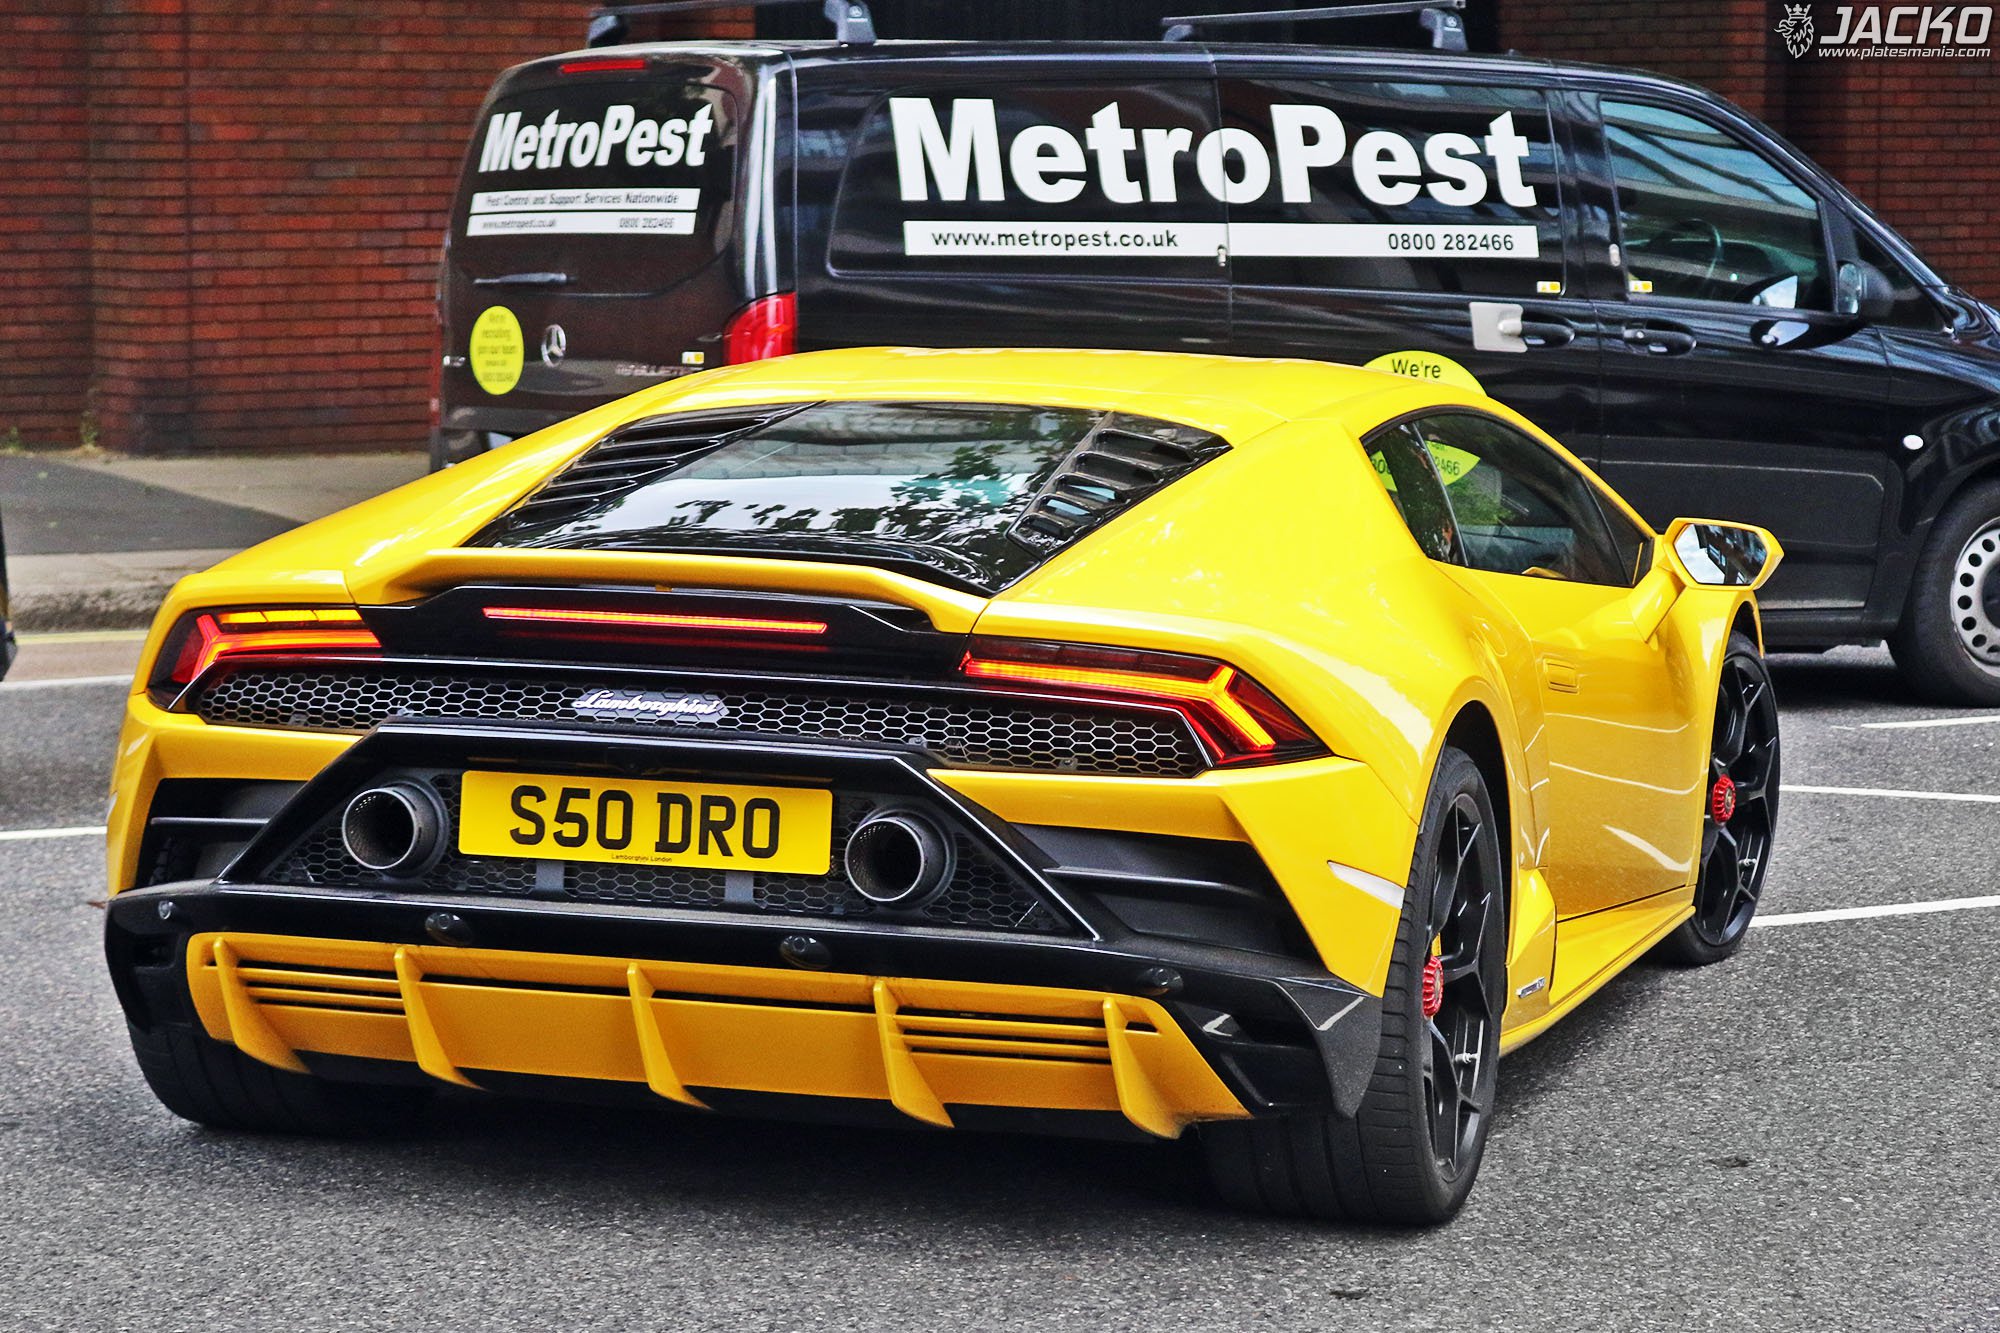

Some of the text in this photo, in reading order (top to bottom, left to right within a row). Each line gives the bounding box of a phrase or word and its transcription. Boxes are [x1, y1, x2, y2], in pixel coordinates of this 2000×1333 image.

[478, 103, 714, 173] MetroPest
[889, 97, 1537, 208] MetroPest
[584, 191, 622, 205] Services
[625, 191, 680, 204] Nationwide
[932, 229, 1514, 251] www.metropest.co.uk 0800 282466
[1391, 358, 1441, 379] We're
[571, 689, 720, 717] Lamborghini
[509, 784, 781, 859] S50 DRO
[611, 852, 673, 863] Lamborghini London
